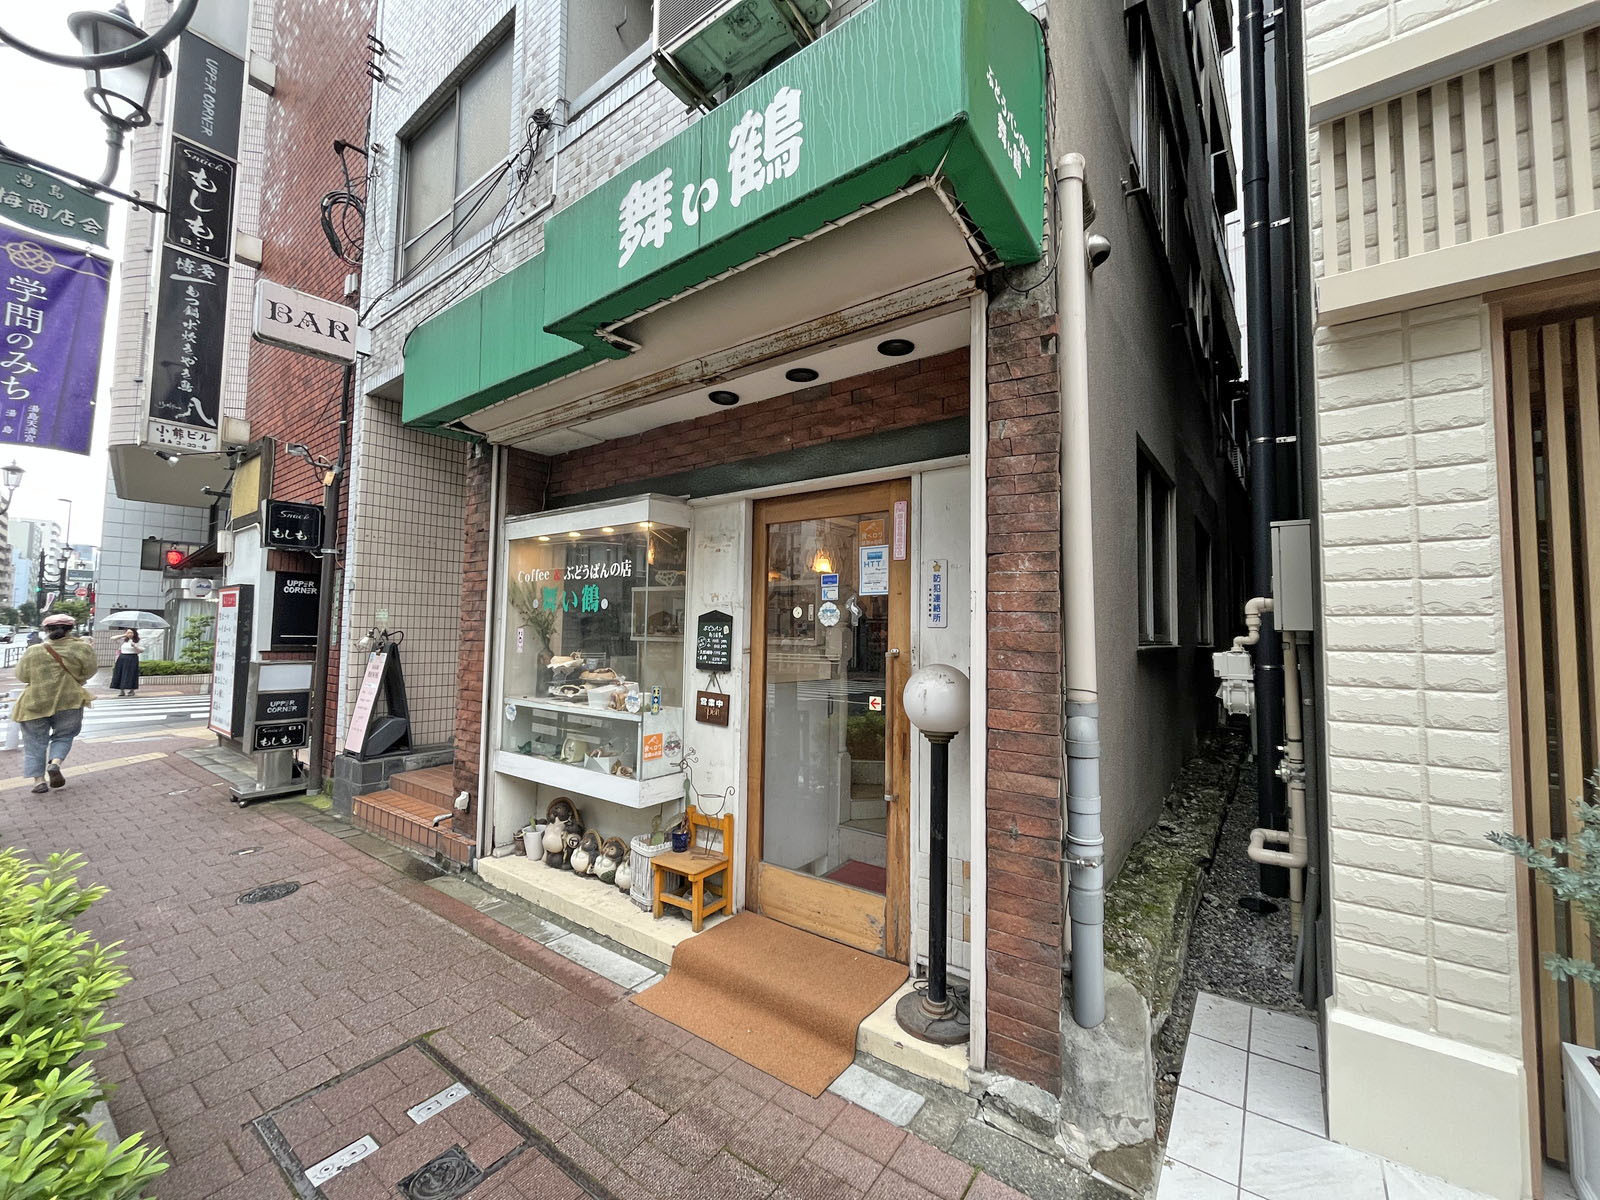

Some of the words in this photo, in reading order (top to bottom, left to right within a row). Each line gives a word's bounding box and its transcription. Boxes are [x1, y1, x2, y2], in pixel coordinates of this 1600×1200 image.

[203, 58, 218, 94] UPPER
[201, 93, 216, 136] CORNER
[183, 149, 226, 173] Snack
[616, 86, 803, 267] 舞い鶴
[175, 257, 216, 280] 博多
[265, 298, 352, 344] BAR
[0, 275, 48, 400] 学問のみち
[286, 580, 315, 588] UPPER
[518, 569, 550, 583] Coffee
[283, 586, 318, 595] CORNER
[932, 573, 941, 623] 防犯連絡所
[266, 706, 298, 714] CORNER
[270, 700, 296, 708] UPPER
